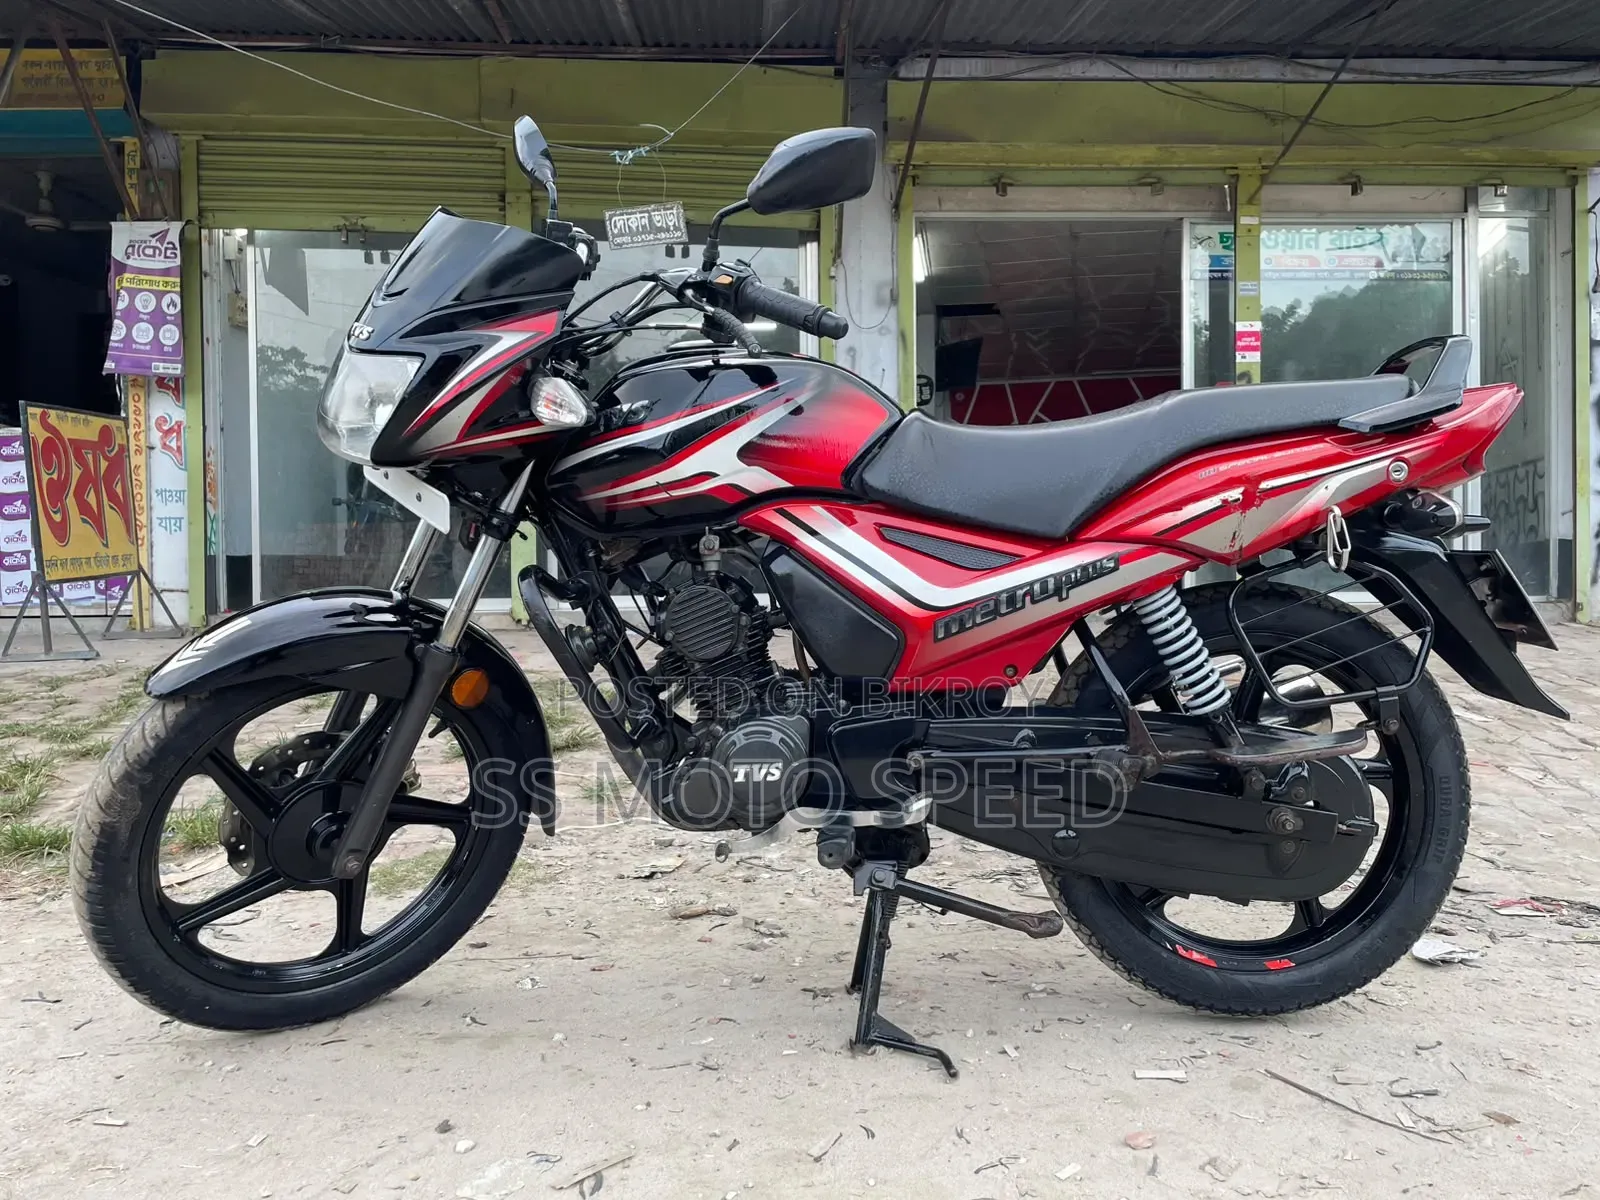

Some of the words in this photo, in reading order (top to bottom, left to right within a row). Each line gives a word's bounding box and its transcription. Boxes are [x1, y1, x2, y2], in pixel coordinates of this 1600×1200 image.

[611, 213, 650, 234] দোকান
[651, 205, 679, 231] ভাড়া
[155, 488, 187, 507] পাওয়া
[157, 516, 185, 536] যায়
[732, 761, 783, 783] TVS
